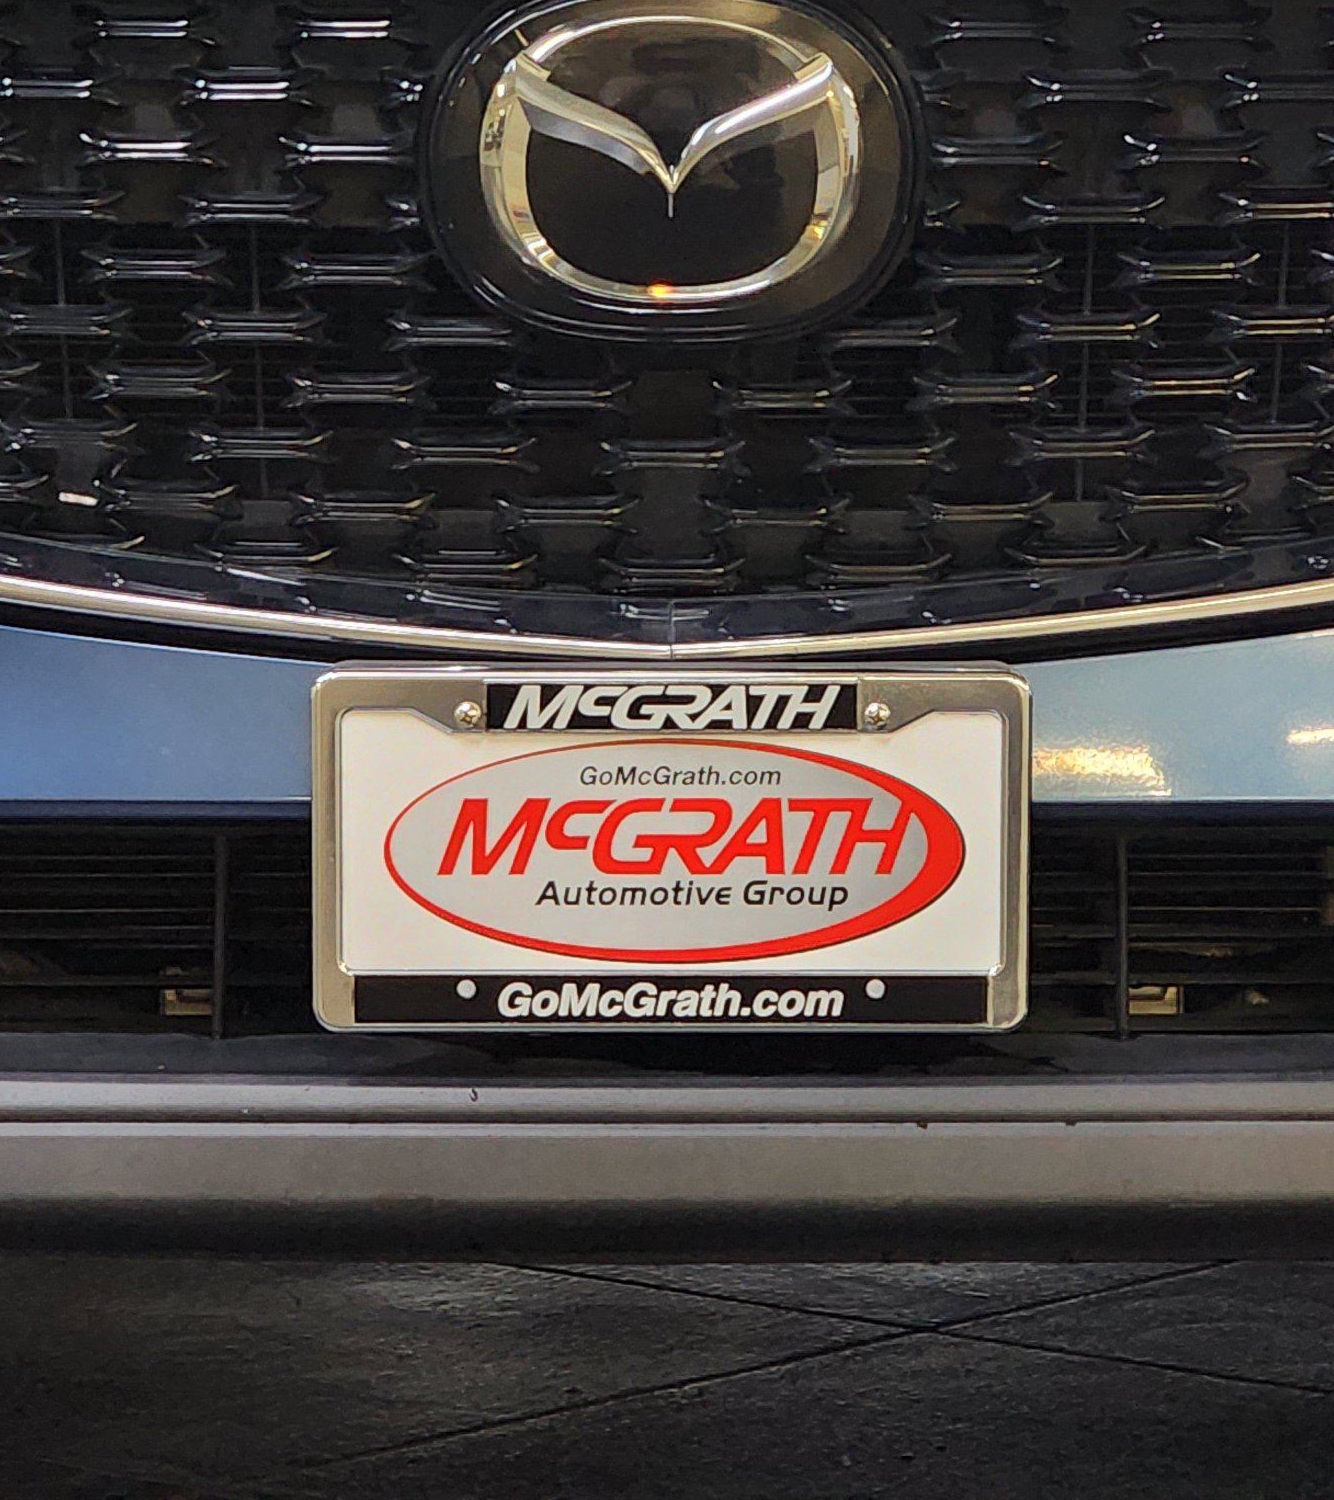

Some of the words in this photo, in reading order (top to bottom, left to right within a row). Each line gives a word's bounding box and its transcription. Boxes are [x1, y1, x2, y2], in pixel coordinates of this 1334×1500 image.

[579, 765, 782, 786] GoMcGrath.com
[535, 879, 733, 906] Automotive
[743, 879, 849, 912] Group
[497, 982, 844, 1018] GoMcGrath.com
